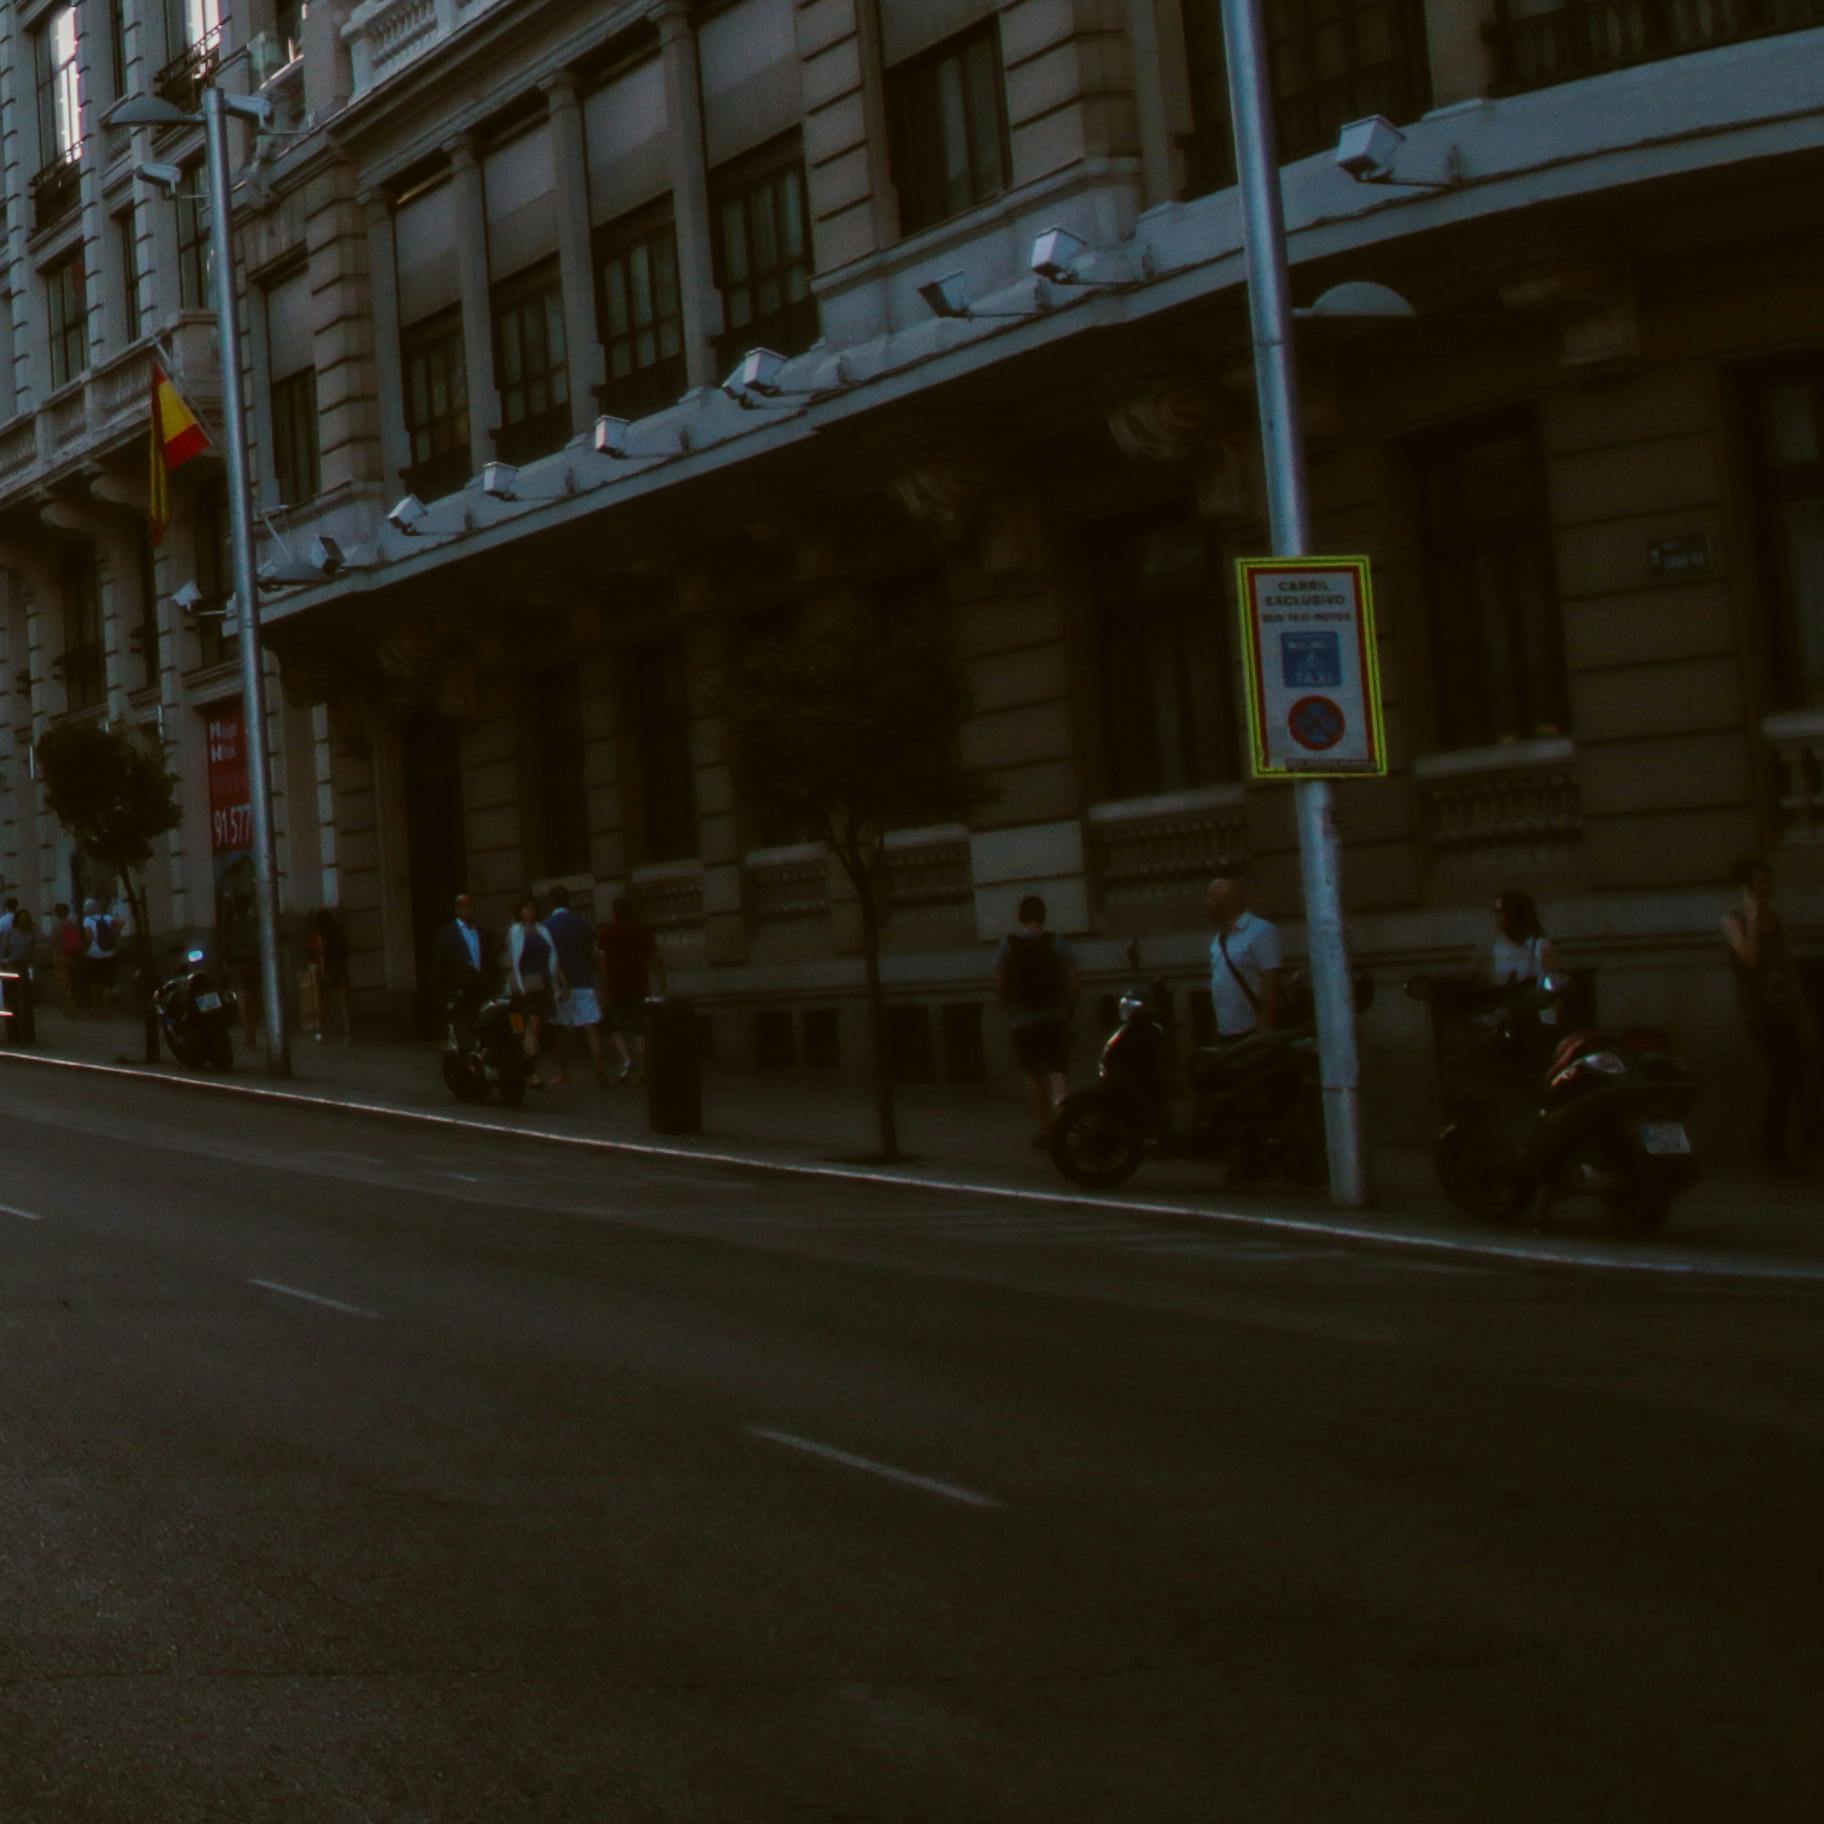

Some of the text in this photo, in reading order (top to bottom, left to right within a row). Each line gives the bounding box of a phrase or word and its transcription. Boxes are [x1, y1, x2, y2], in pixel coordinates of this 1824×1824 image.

[1278, 580, 1330, 592] CARRIL
[1264, 594, 1345, 607] EXCLUSIVO
[1295, 671, 1333, 684] TAXI
